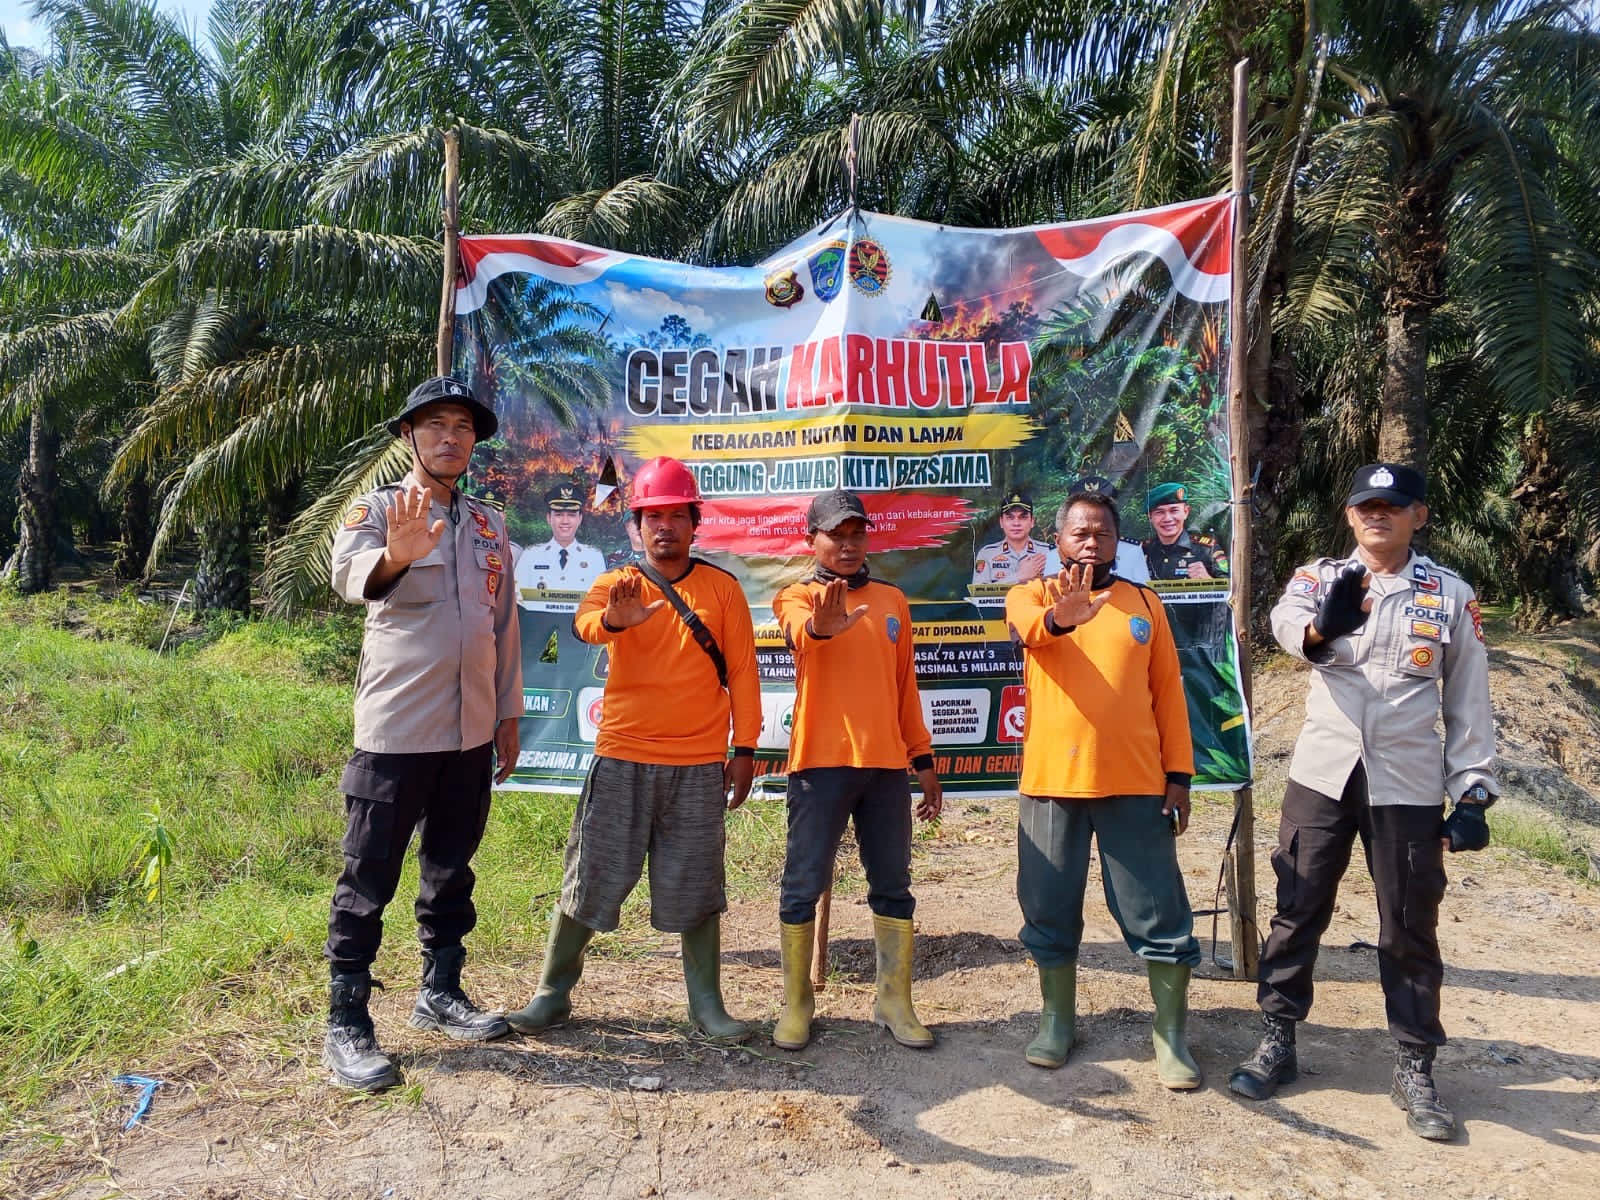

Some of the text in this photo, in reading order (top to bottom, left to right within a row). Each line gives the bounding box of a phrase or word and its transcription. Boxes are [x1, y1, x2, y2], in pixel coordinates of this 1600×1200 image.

[626, 334, 1032, 417] CEGAH KARHUTLA
[692, 423, 964, 451] KEBAKARAN HUTAN DAN LAHAN
[769, 458, 838, 492] JAWAB
[841, 457, 890, 490] KITA
[894, 455, 990, 488] BERSAMA
[718, 515, 735, 525] kita
[735, 515, 757, 527] jaga
[886, 511, 905, 520] dari
[907, 509, 956, 519] kebakaran
[749, 526, 771, 535] demi
[773, 527, 798, 535] masa
[880, 521, 897, 531] kita
[1404, 606, 1449, 624] POLRI
[755, 625, 986, 640] KARA PAT DIPIDANA
[914, 651, 940, 661] ASAL
[942, 651, 955, 660] 78
[958, 650, 985, 660] AYAT
[988, 649, 995, 659] 3
[763, 667, 796, 677] TAHUN
[915, 664, 959, 674] AKSIMAL
[961, 663, 968, 673] 5
[971, 662, 1006, 672] MILIAR
[523, 695, 550, 712] KAN
[931, 699, 971, 708] LAPORKAN
[932, 707, 978, 717] SEGERA JIKA
[932, 726, 977, 735] KEBAKARAN
[516, 750, 578, 770] BERSAMA
[954, 755, 983, 774] DAN
[985, 755, 1024, 773] GENE
